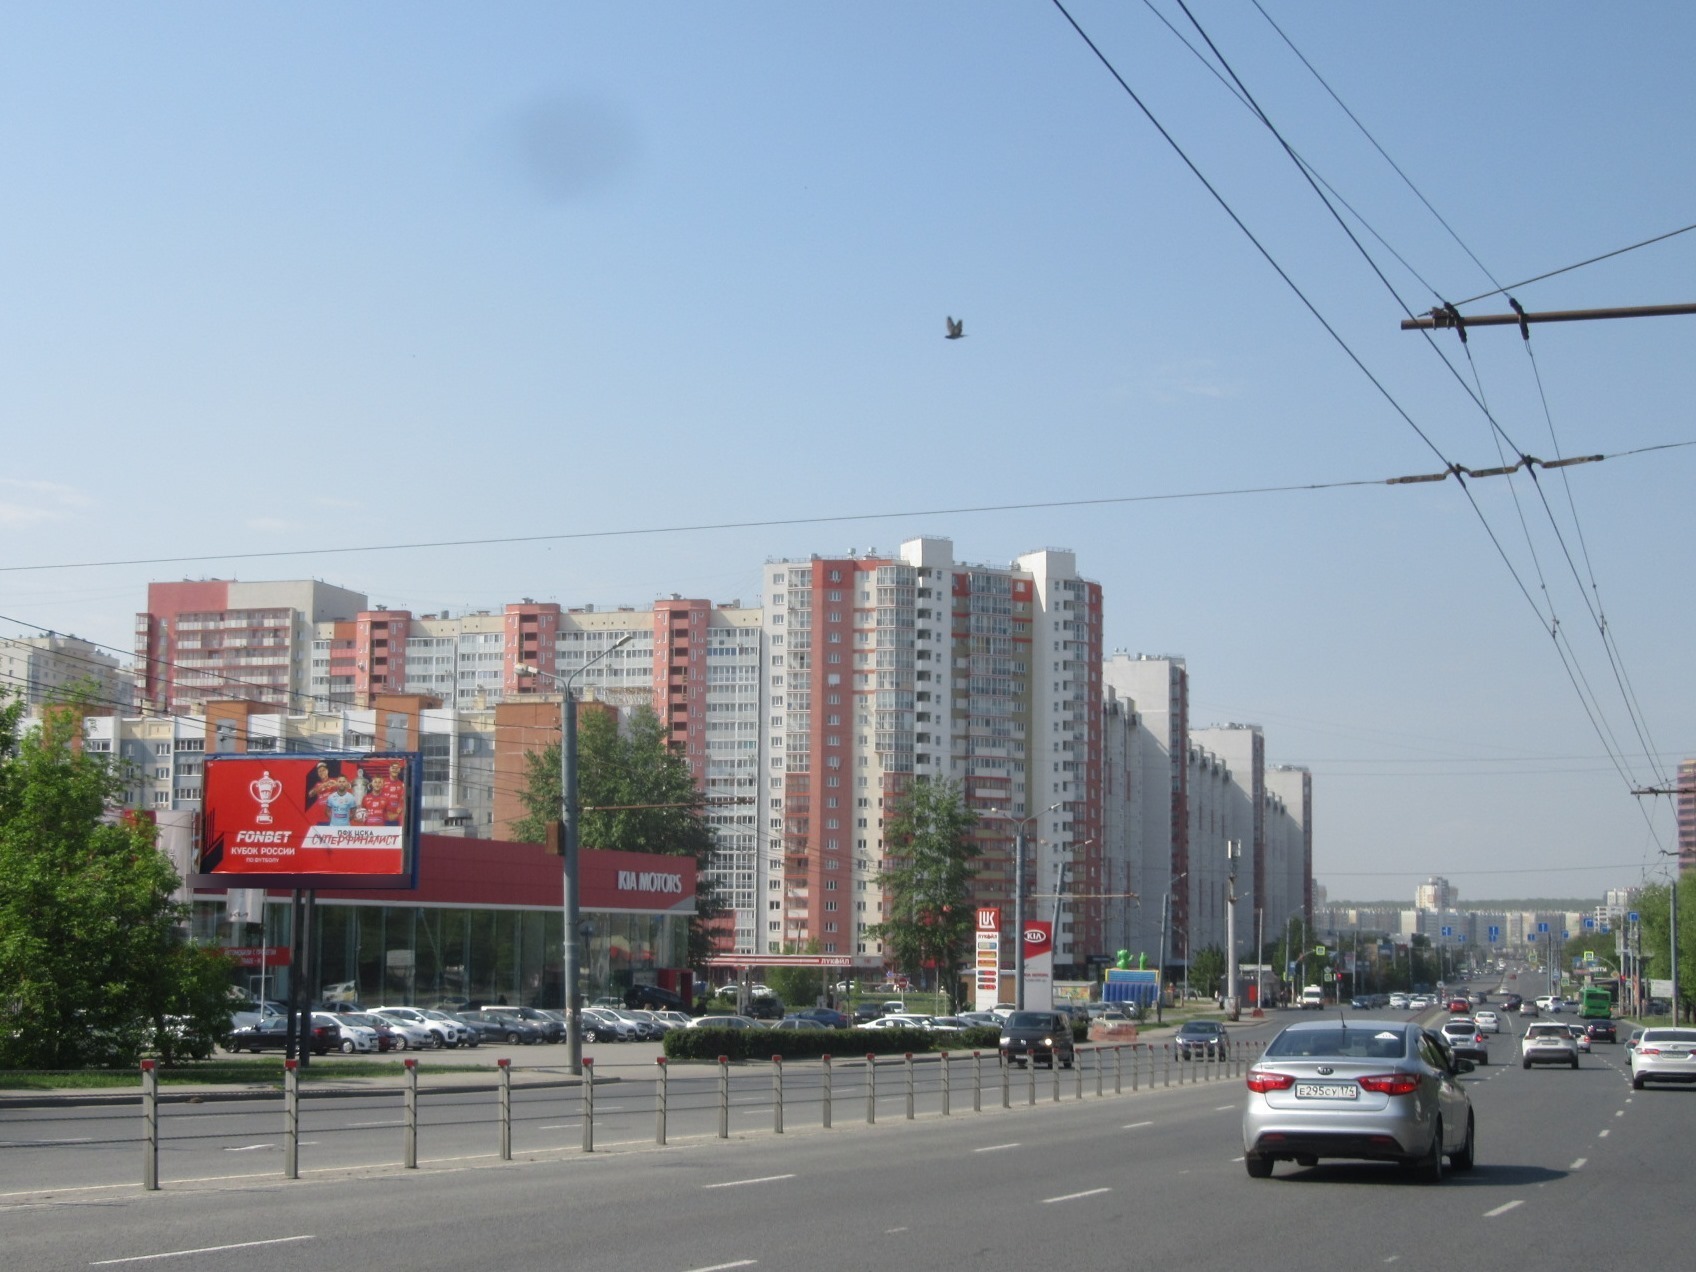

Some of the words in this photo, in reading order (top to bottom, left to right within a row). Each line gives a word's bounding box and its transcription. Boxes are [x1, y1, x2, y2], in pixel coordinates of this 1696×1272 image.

[236, 830, 292, 843] FONBET
[354, 829, 374, 837] ЦСКА
[311, 834, 400, 846] СУПЕРФИНАЛИСТ
[231, 847, 258, 855] КУБОК
[260, 847, 295, 855] РОССИИ
[617, 870, 637, 890] KIA
[638, 872, 682, 893] MOTORS
[821, 957, 850, 965] ЛУКОЙЛ
